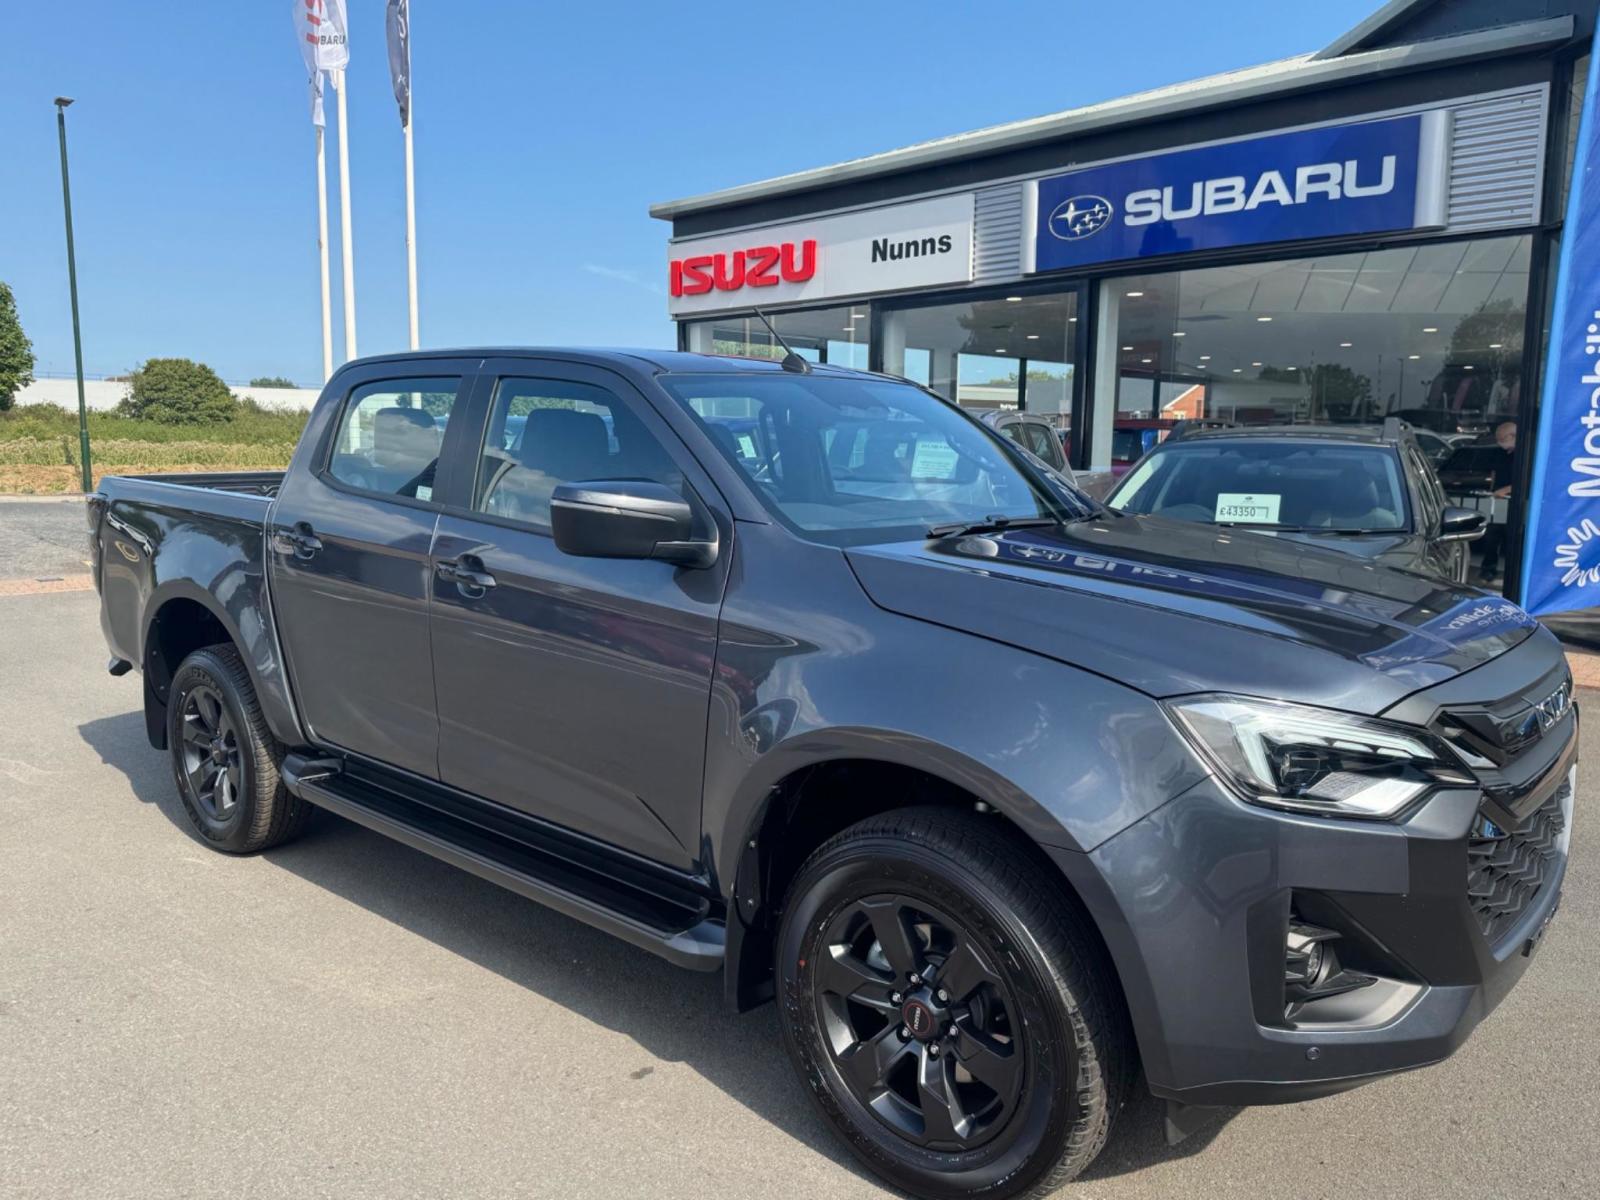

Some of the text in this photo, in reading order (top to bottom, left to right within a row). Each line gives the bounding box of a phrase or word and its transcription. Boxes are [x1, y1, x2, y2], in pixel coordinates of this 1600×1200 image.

[316, 35, 346, 45] BARU
[1124, 155, 1397, 226] SUBARU
[670, 239, 817, 297] ISUZU
[871, 234, 952, 263] Nunns
